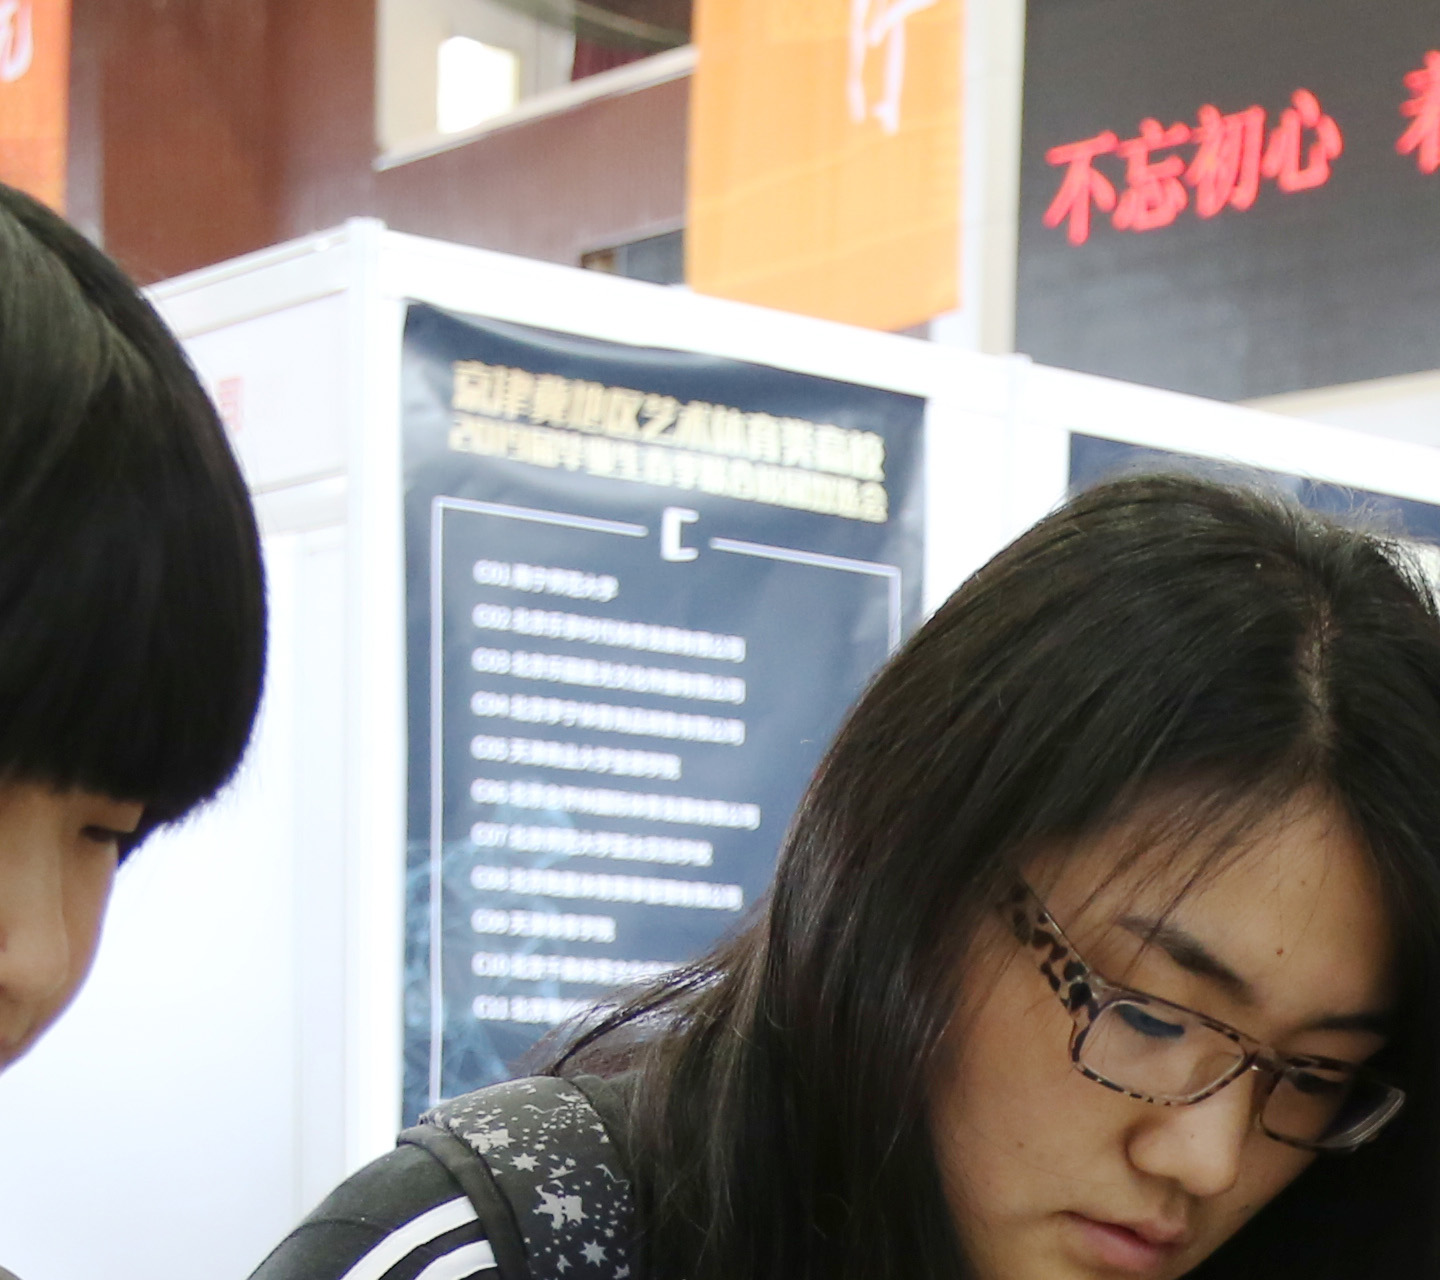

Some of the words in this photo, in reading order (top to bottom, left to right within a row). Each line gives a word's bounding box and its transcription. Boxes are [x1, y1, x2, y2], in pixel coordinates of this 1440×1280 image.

[1042, 87, 1342, 246] 不忘初心
[660, 506, 699, 562] C
